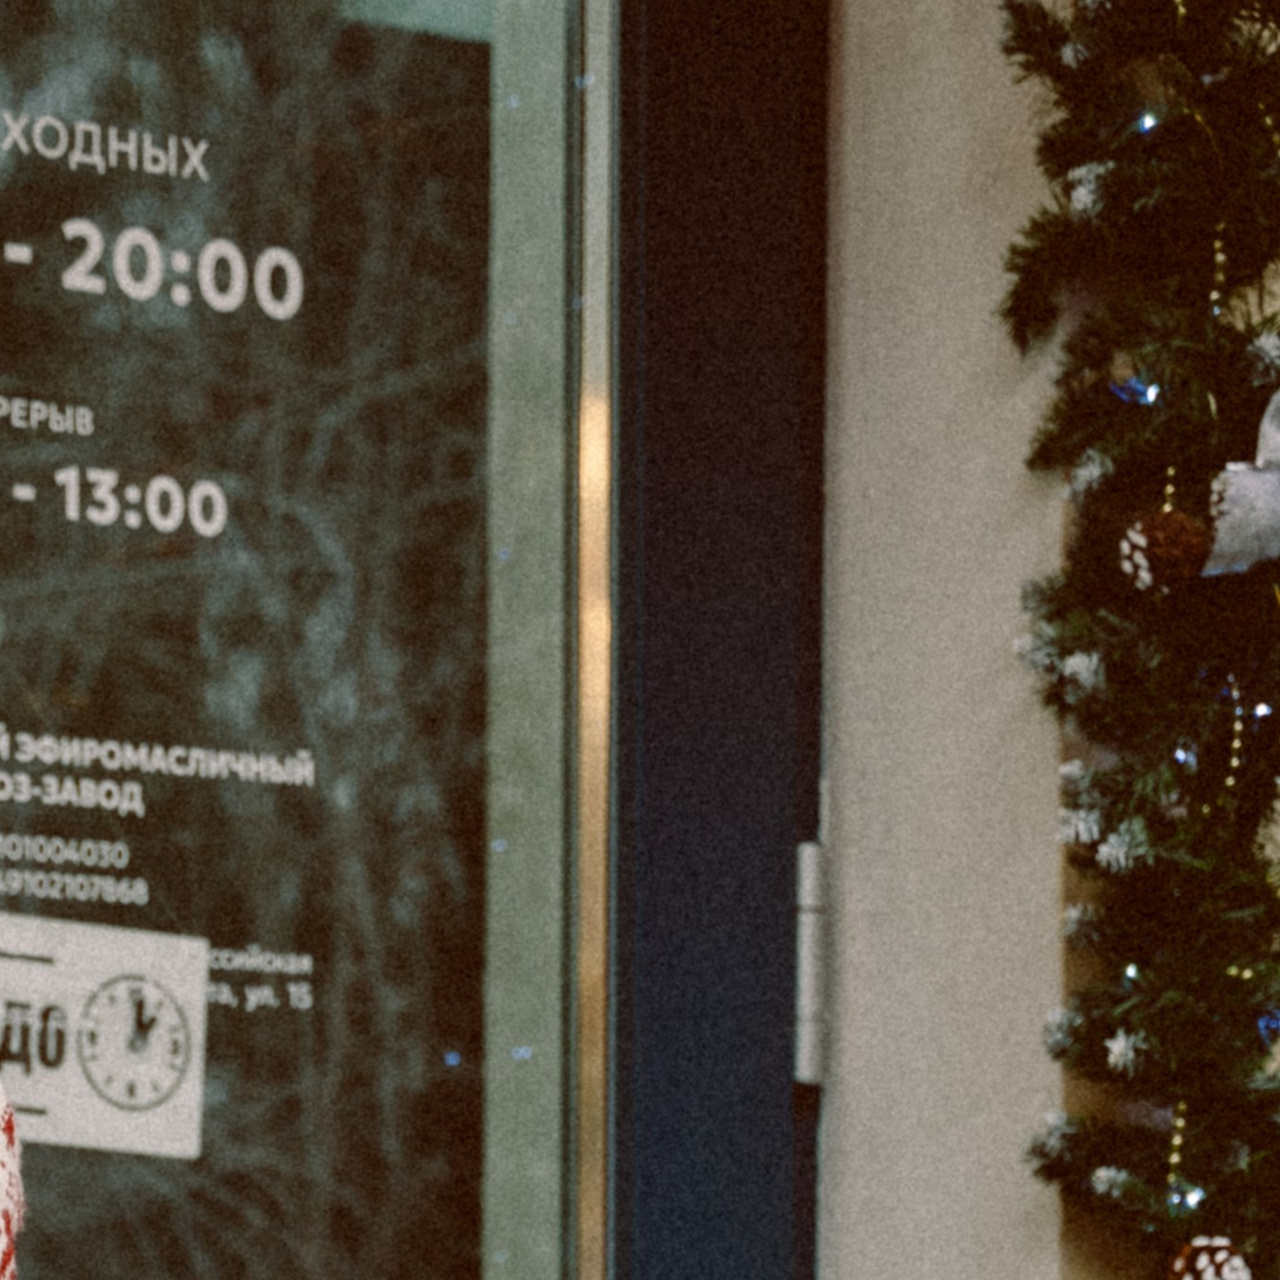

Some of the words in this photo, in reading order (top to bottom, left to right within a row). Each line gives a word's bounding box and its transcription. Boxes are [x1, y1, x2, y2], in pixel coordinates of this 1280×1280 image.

[60, 217, 304, 320] 20:00
[54, 465, 227, 538] 13:00
[14, 732, 315, 787] ЭФИРОМАСЛИЧНЫЙ
